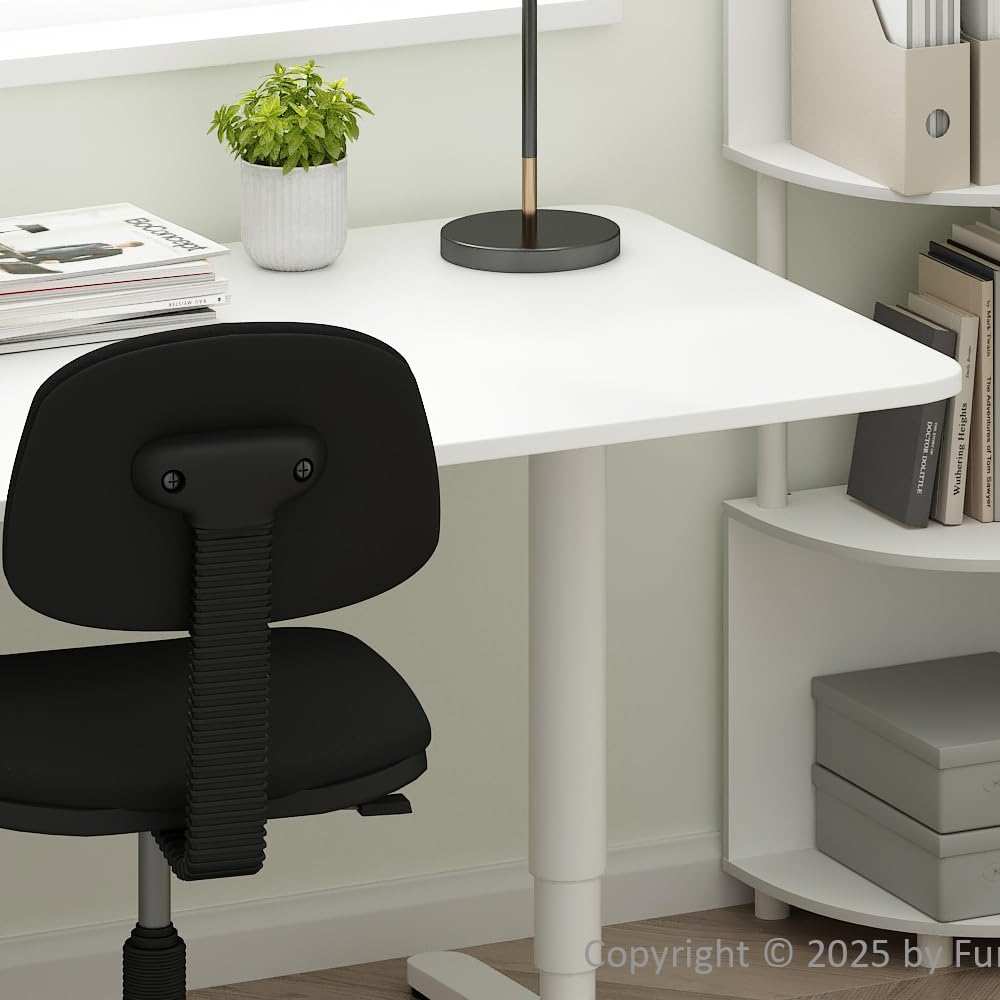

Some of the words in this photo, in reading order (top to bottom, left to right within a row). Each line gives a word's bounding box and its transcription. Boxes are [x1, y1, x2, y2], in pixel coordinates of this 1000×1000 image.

[124, 217, 208, 252] BoConcept
[923, 421, 933, 454] DOCTOR
[958, 402, 968, 441] Heights
[986, 445, 992, 454] of
[916, 455, 928, 495] DOLITTLE
[953, 443, 966, 496] Wuthering
